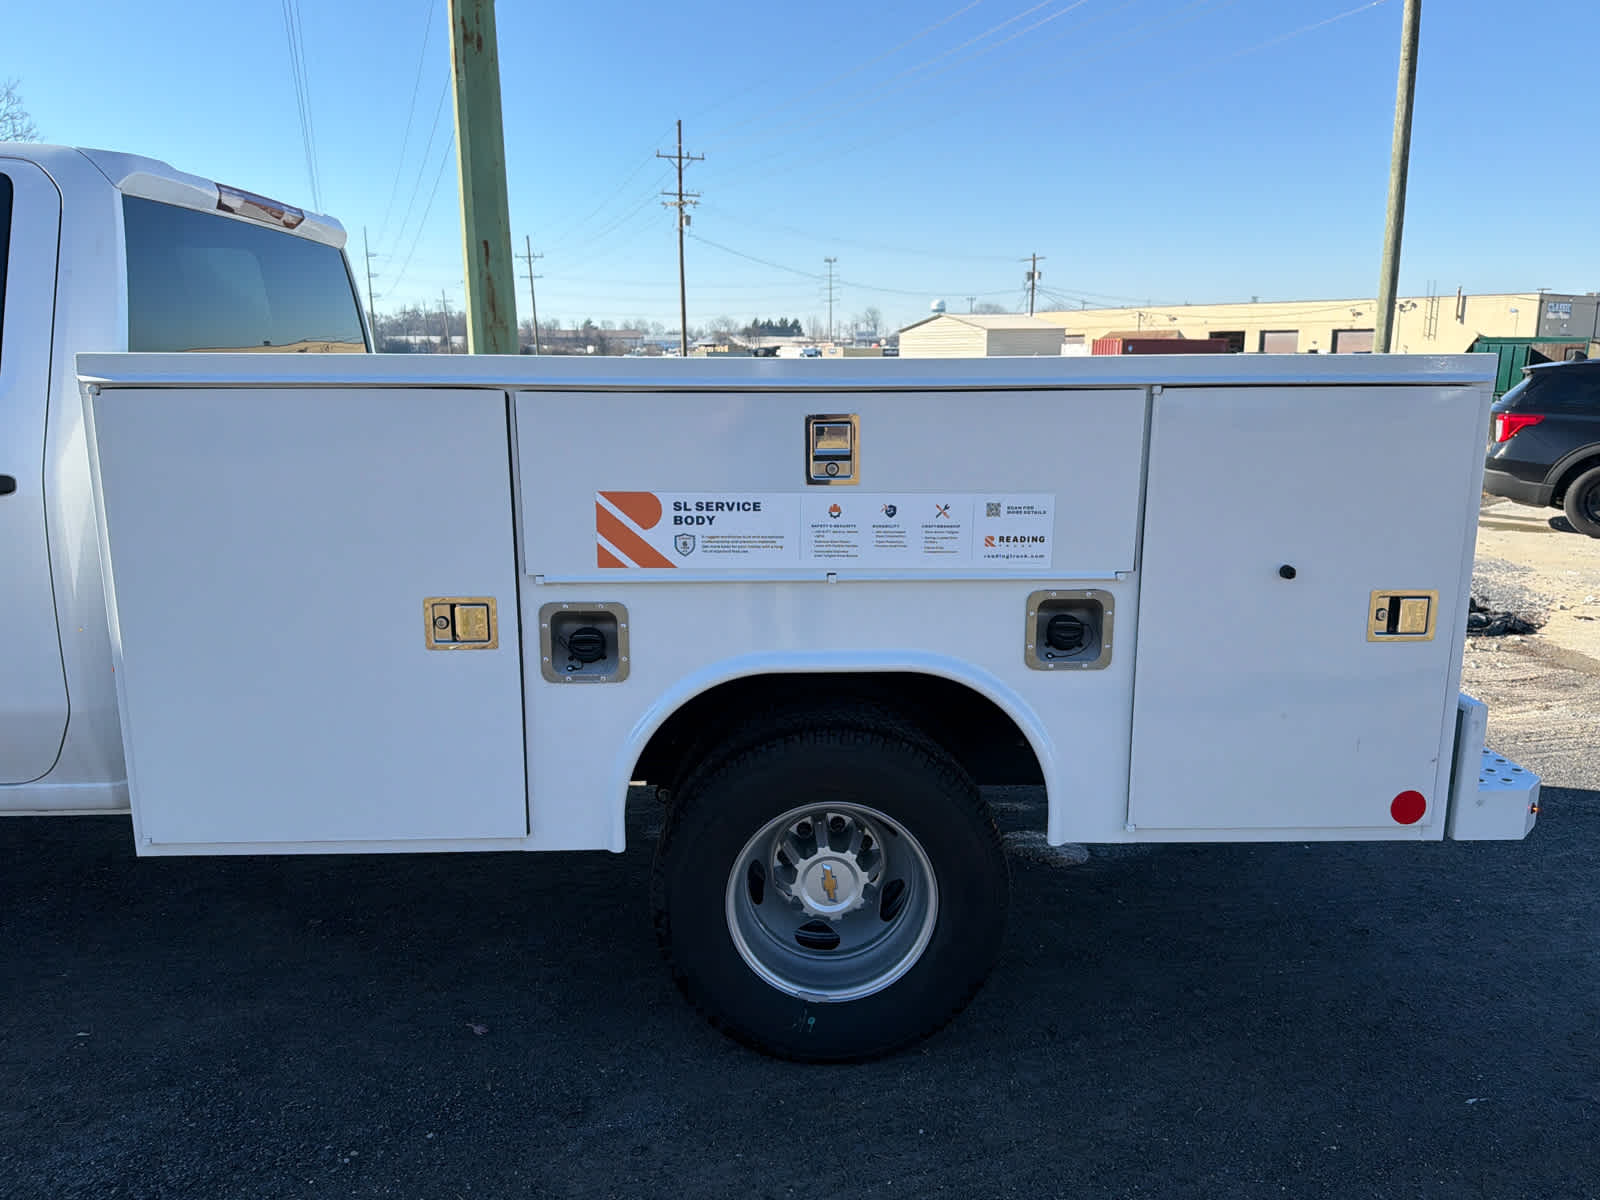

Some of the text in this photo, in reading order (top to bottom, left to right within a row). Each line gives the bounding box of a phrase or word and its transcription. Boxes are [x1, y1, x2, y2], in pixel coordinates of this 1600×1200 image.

[673, 501, 761, 512] SL SERVICE
[673, 515, 716, 526] BODY
[998, 535, 1045, 543] READING
